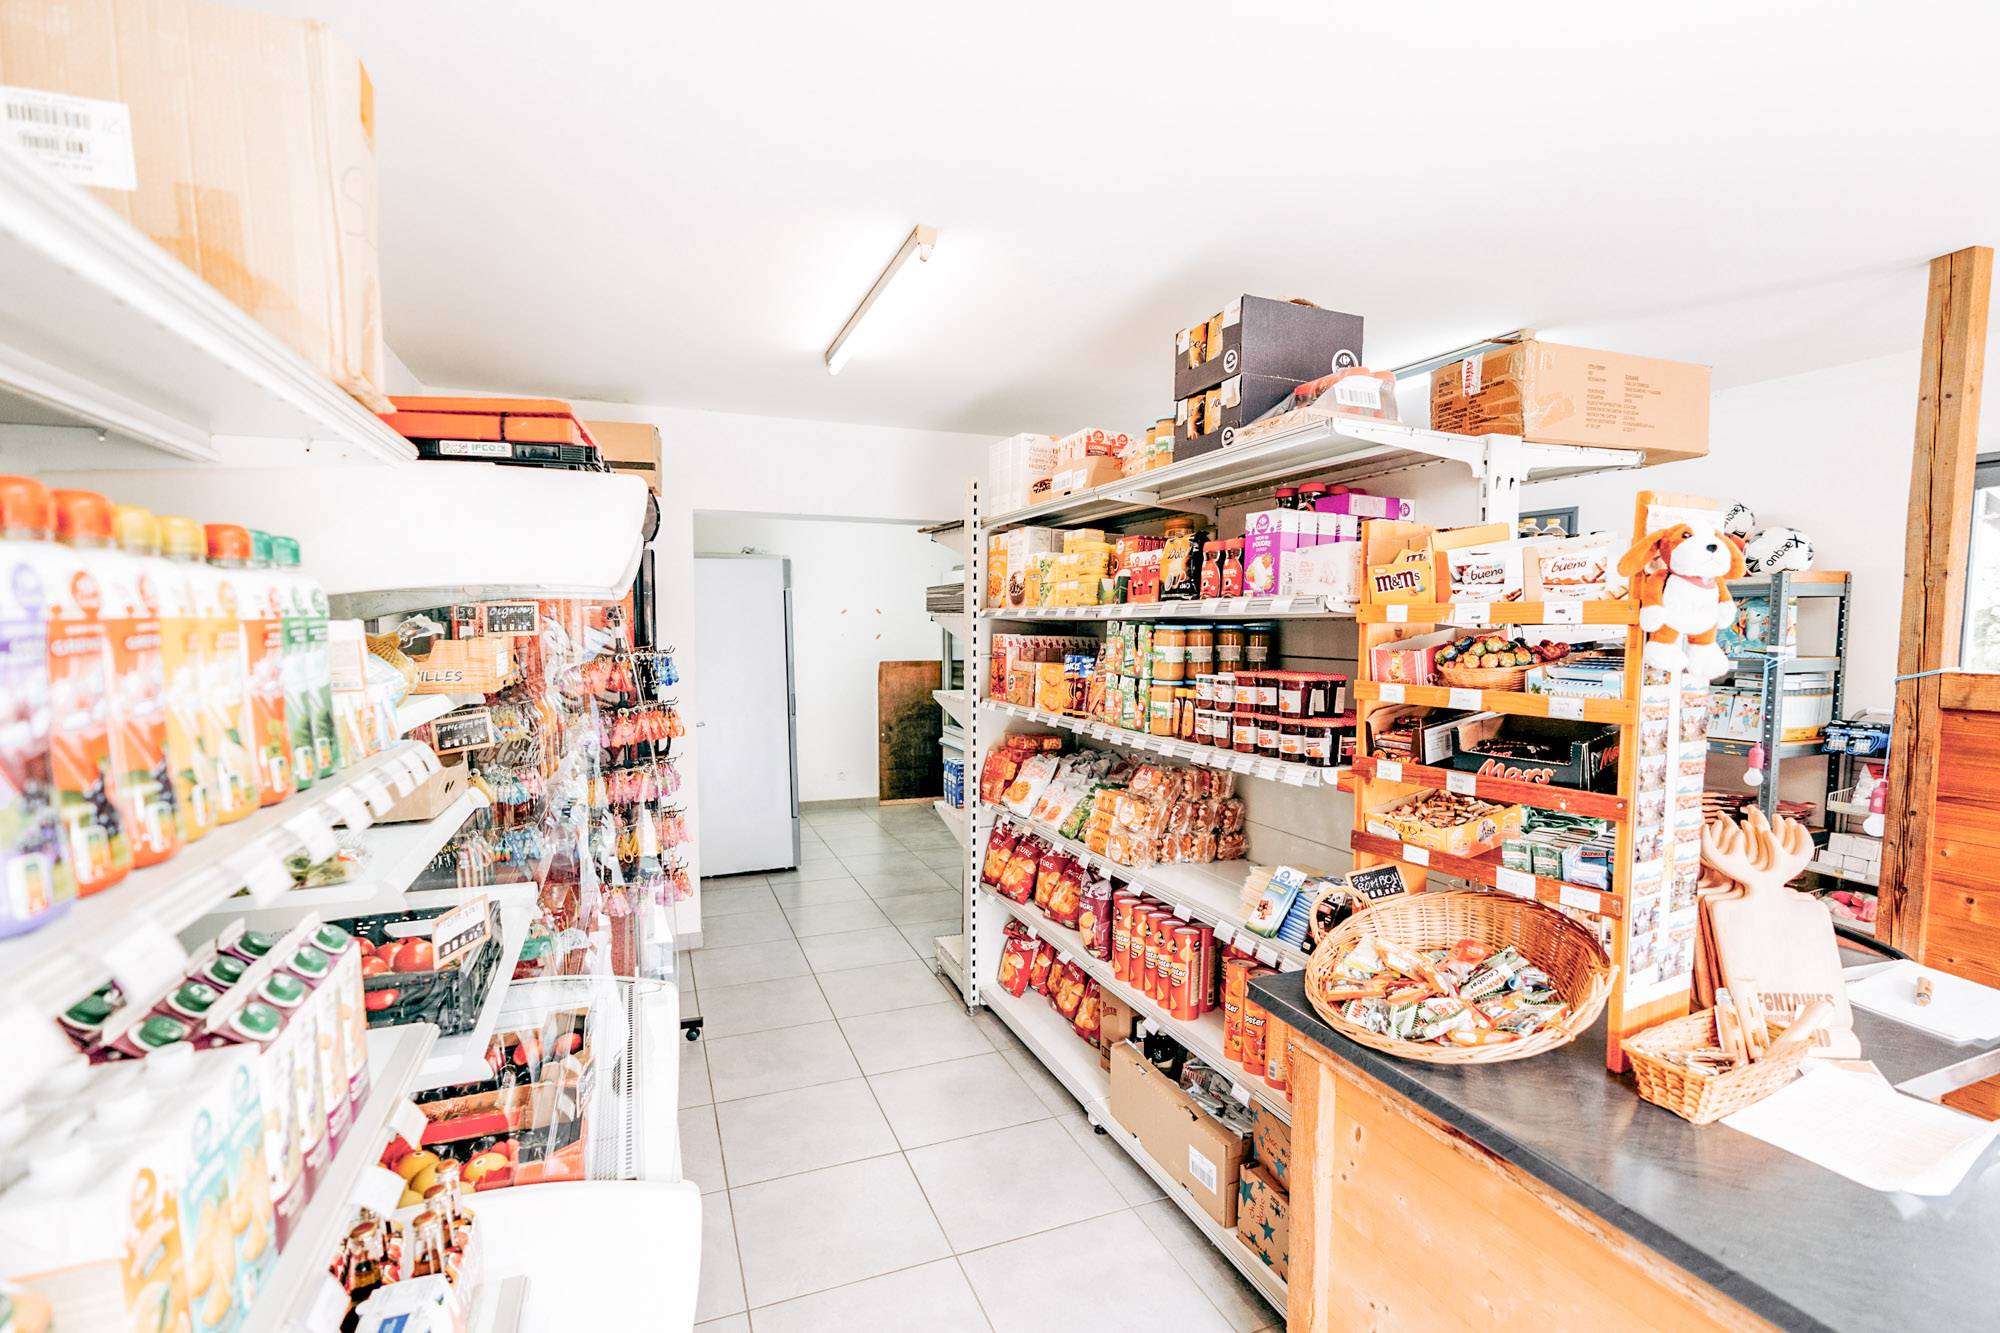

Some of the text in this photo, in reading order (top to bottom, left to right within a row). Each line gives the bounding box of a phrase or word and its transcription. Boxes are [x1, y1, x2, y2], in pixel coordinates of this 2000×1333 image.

[471, 444, 496, 452] IFCO
[1470, 566, 1504, 581] bueno
[1551, 560, 1587, 574] bueno
[1478, 758, 1557, 785] Mars
